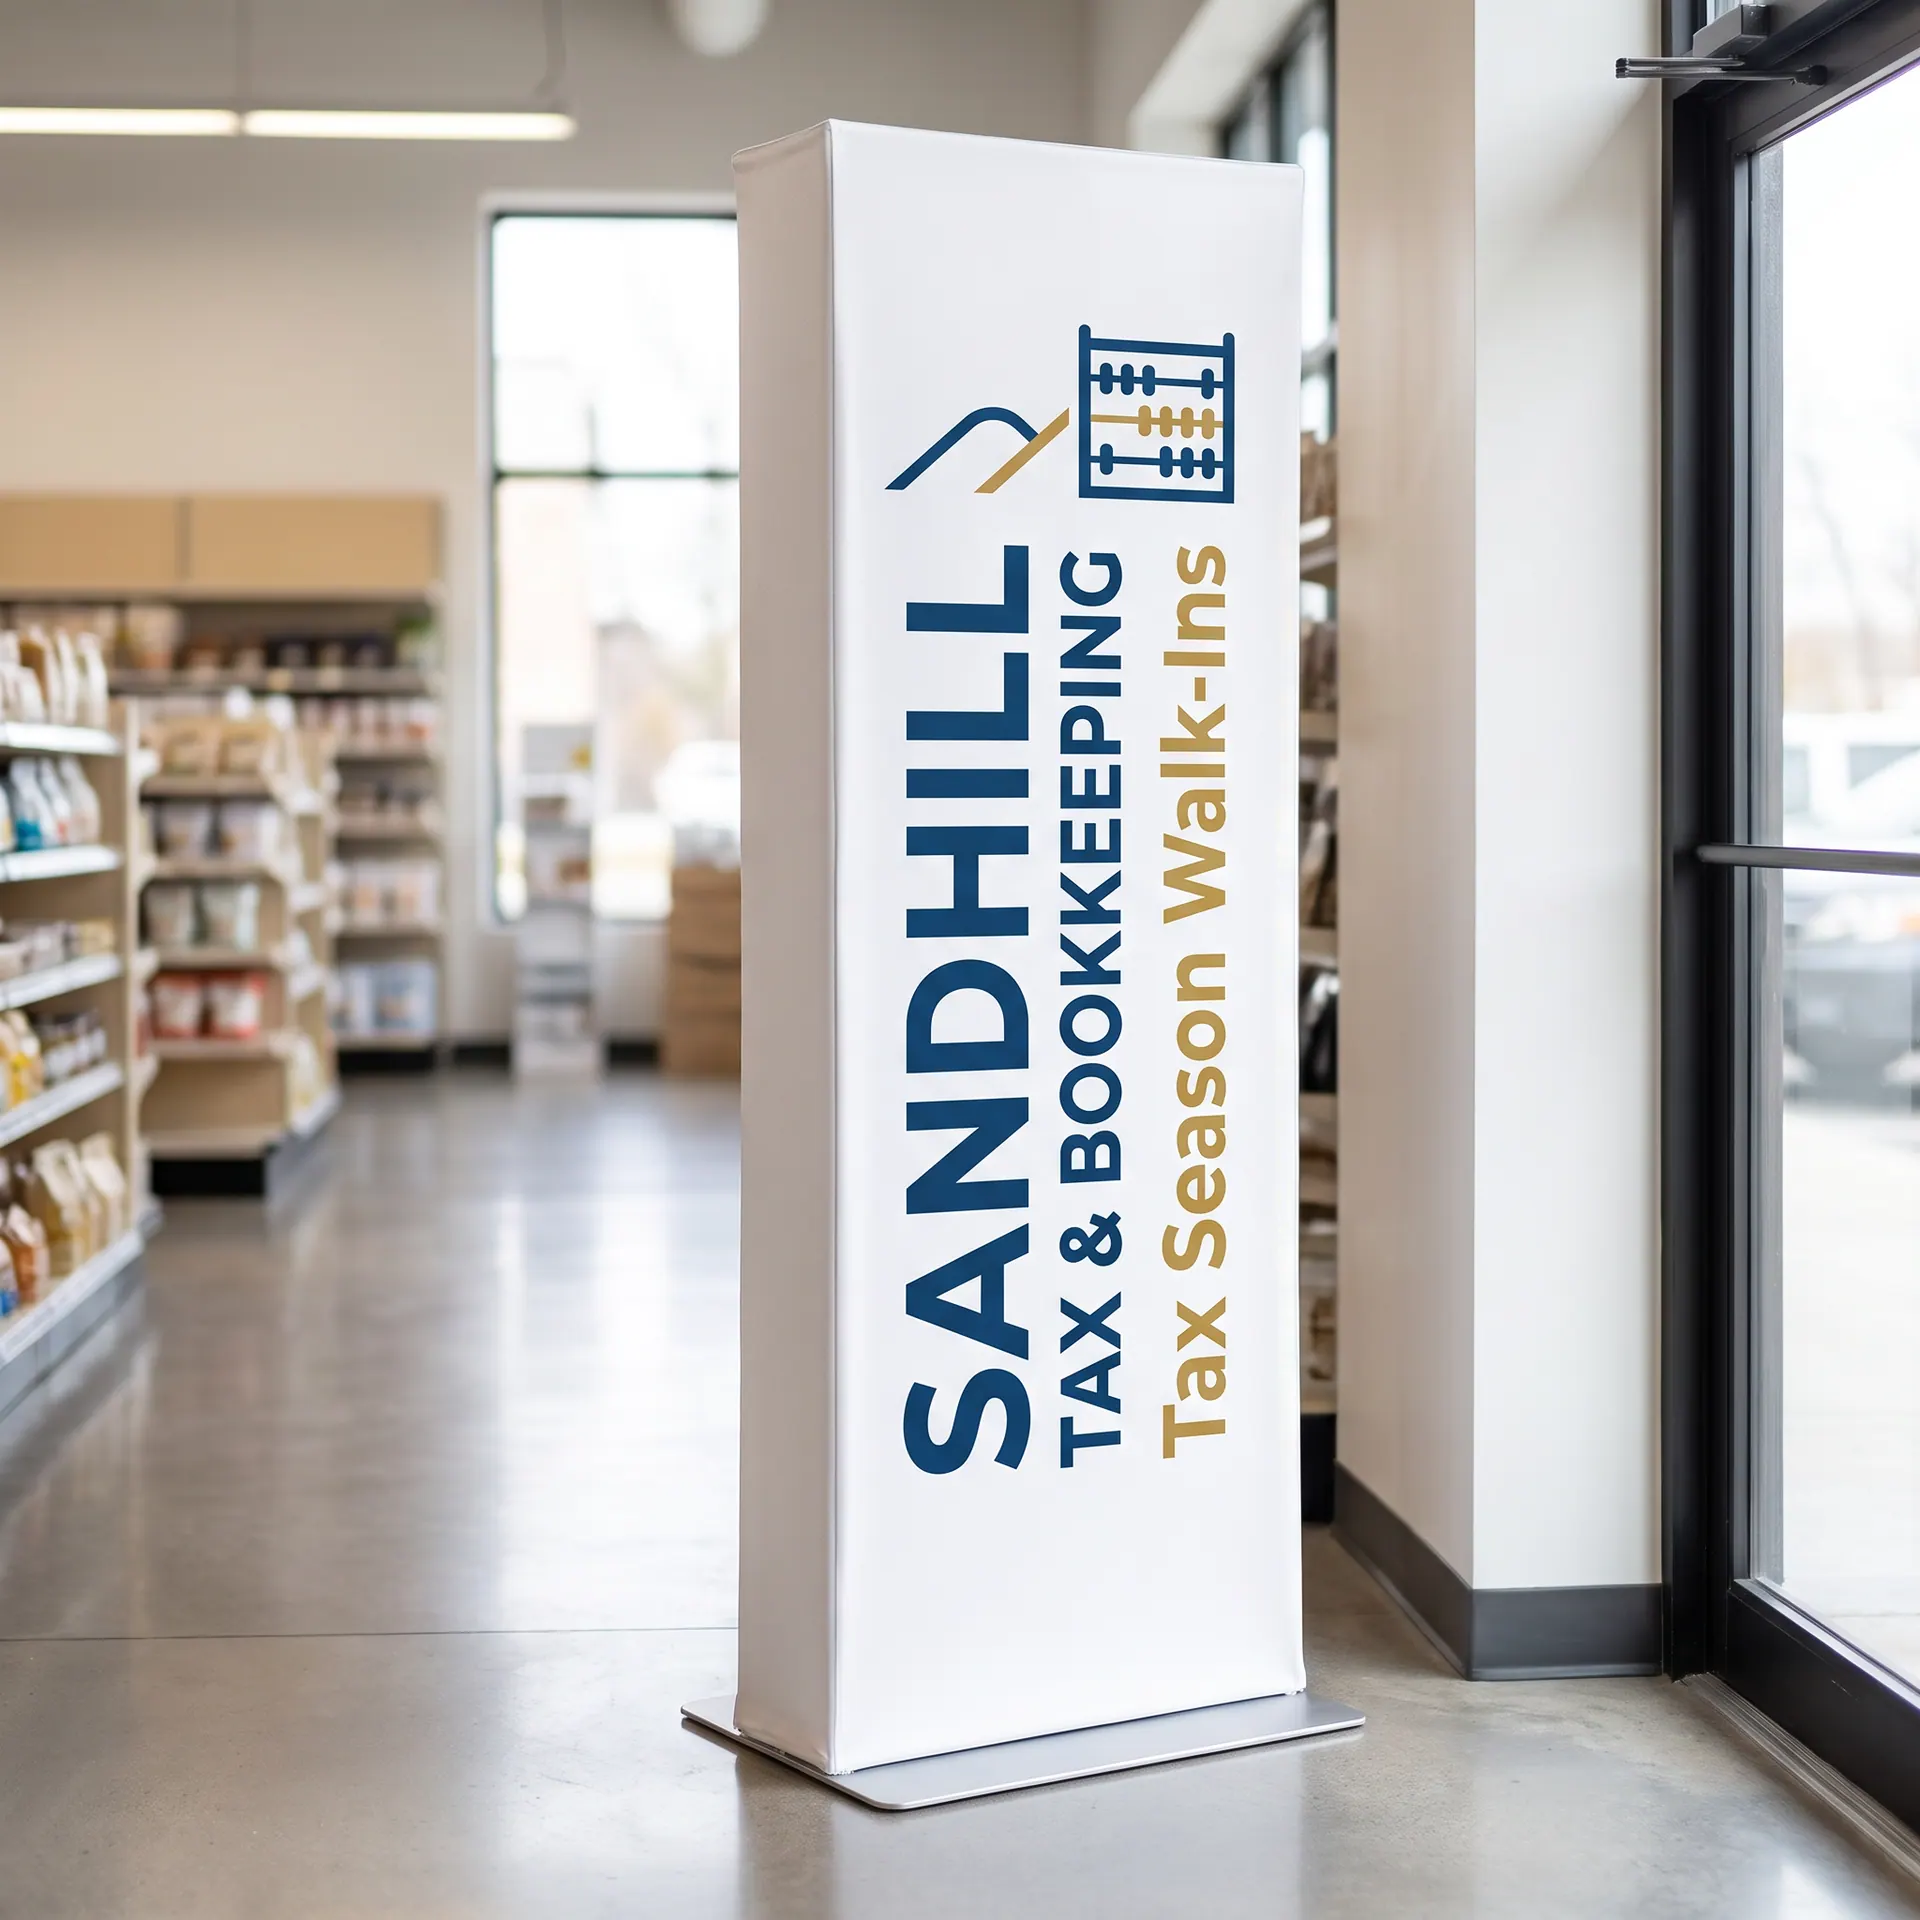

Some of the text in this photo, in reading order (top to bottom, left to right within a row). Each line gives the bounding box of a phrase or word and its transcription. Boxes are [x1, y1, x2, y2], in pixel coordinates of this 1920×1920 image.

[903, 545, 1030, 1474] SANDHILL
[1060, 552, 1122, 1468] TAX & BOOKKEEPING
[1160, 546, 1226, 1458] Tax Season Walk-Ins
